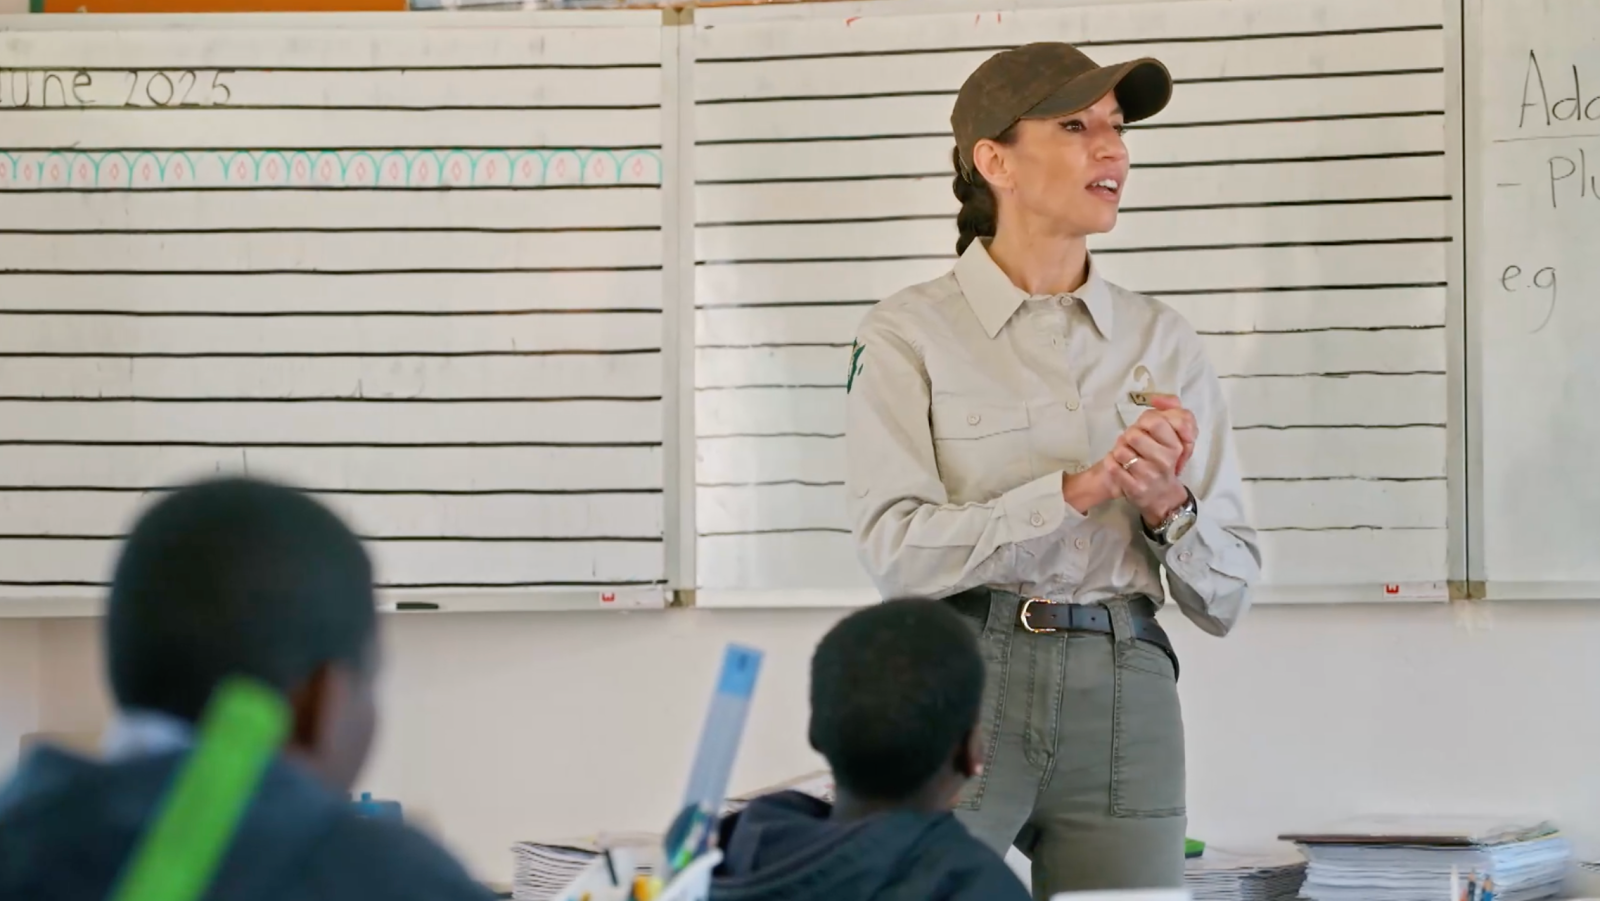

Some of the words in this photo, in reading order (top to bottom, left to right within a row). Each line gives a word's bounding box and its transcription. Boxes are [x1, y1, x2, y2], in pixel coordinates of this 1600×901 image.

[0, 69, 96, 107] une
[123, 69, 236, 107] 2025
[1501, 264, 1556, 334] e.g
